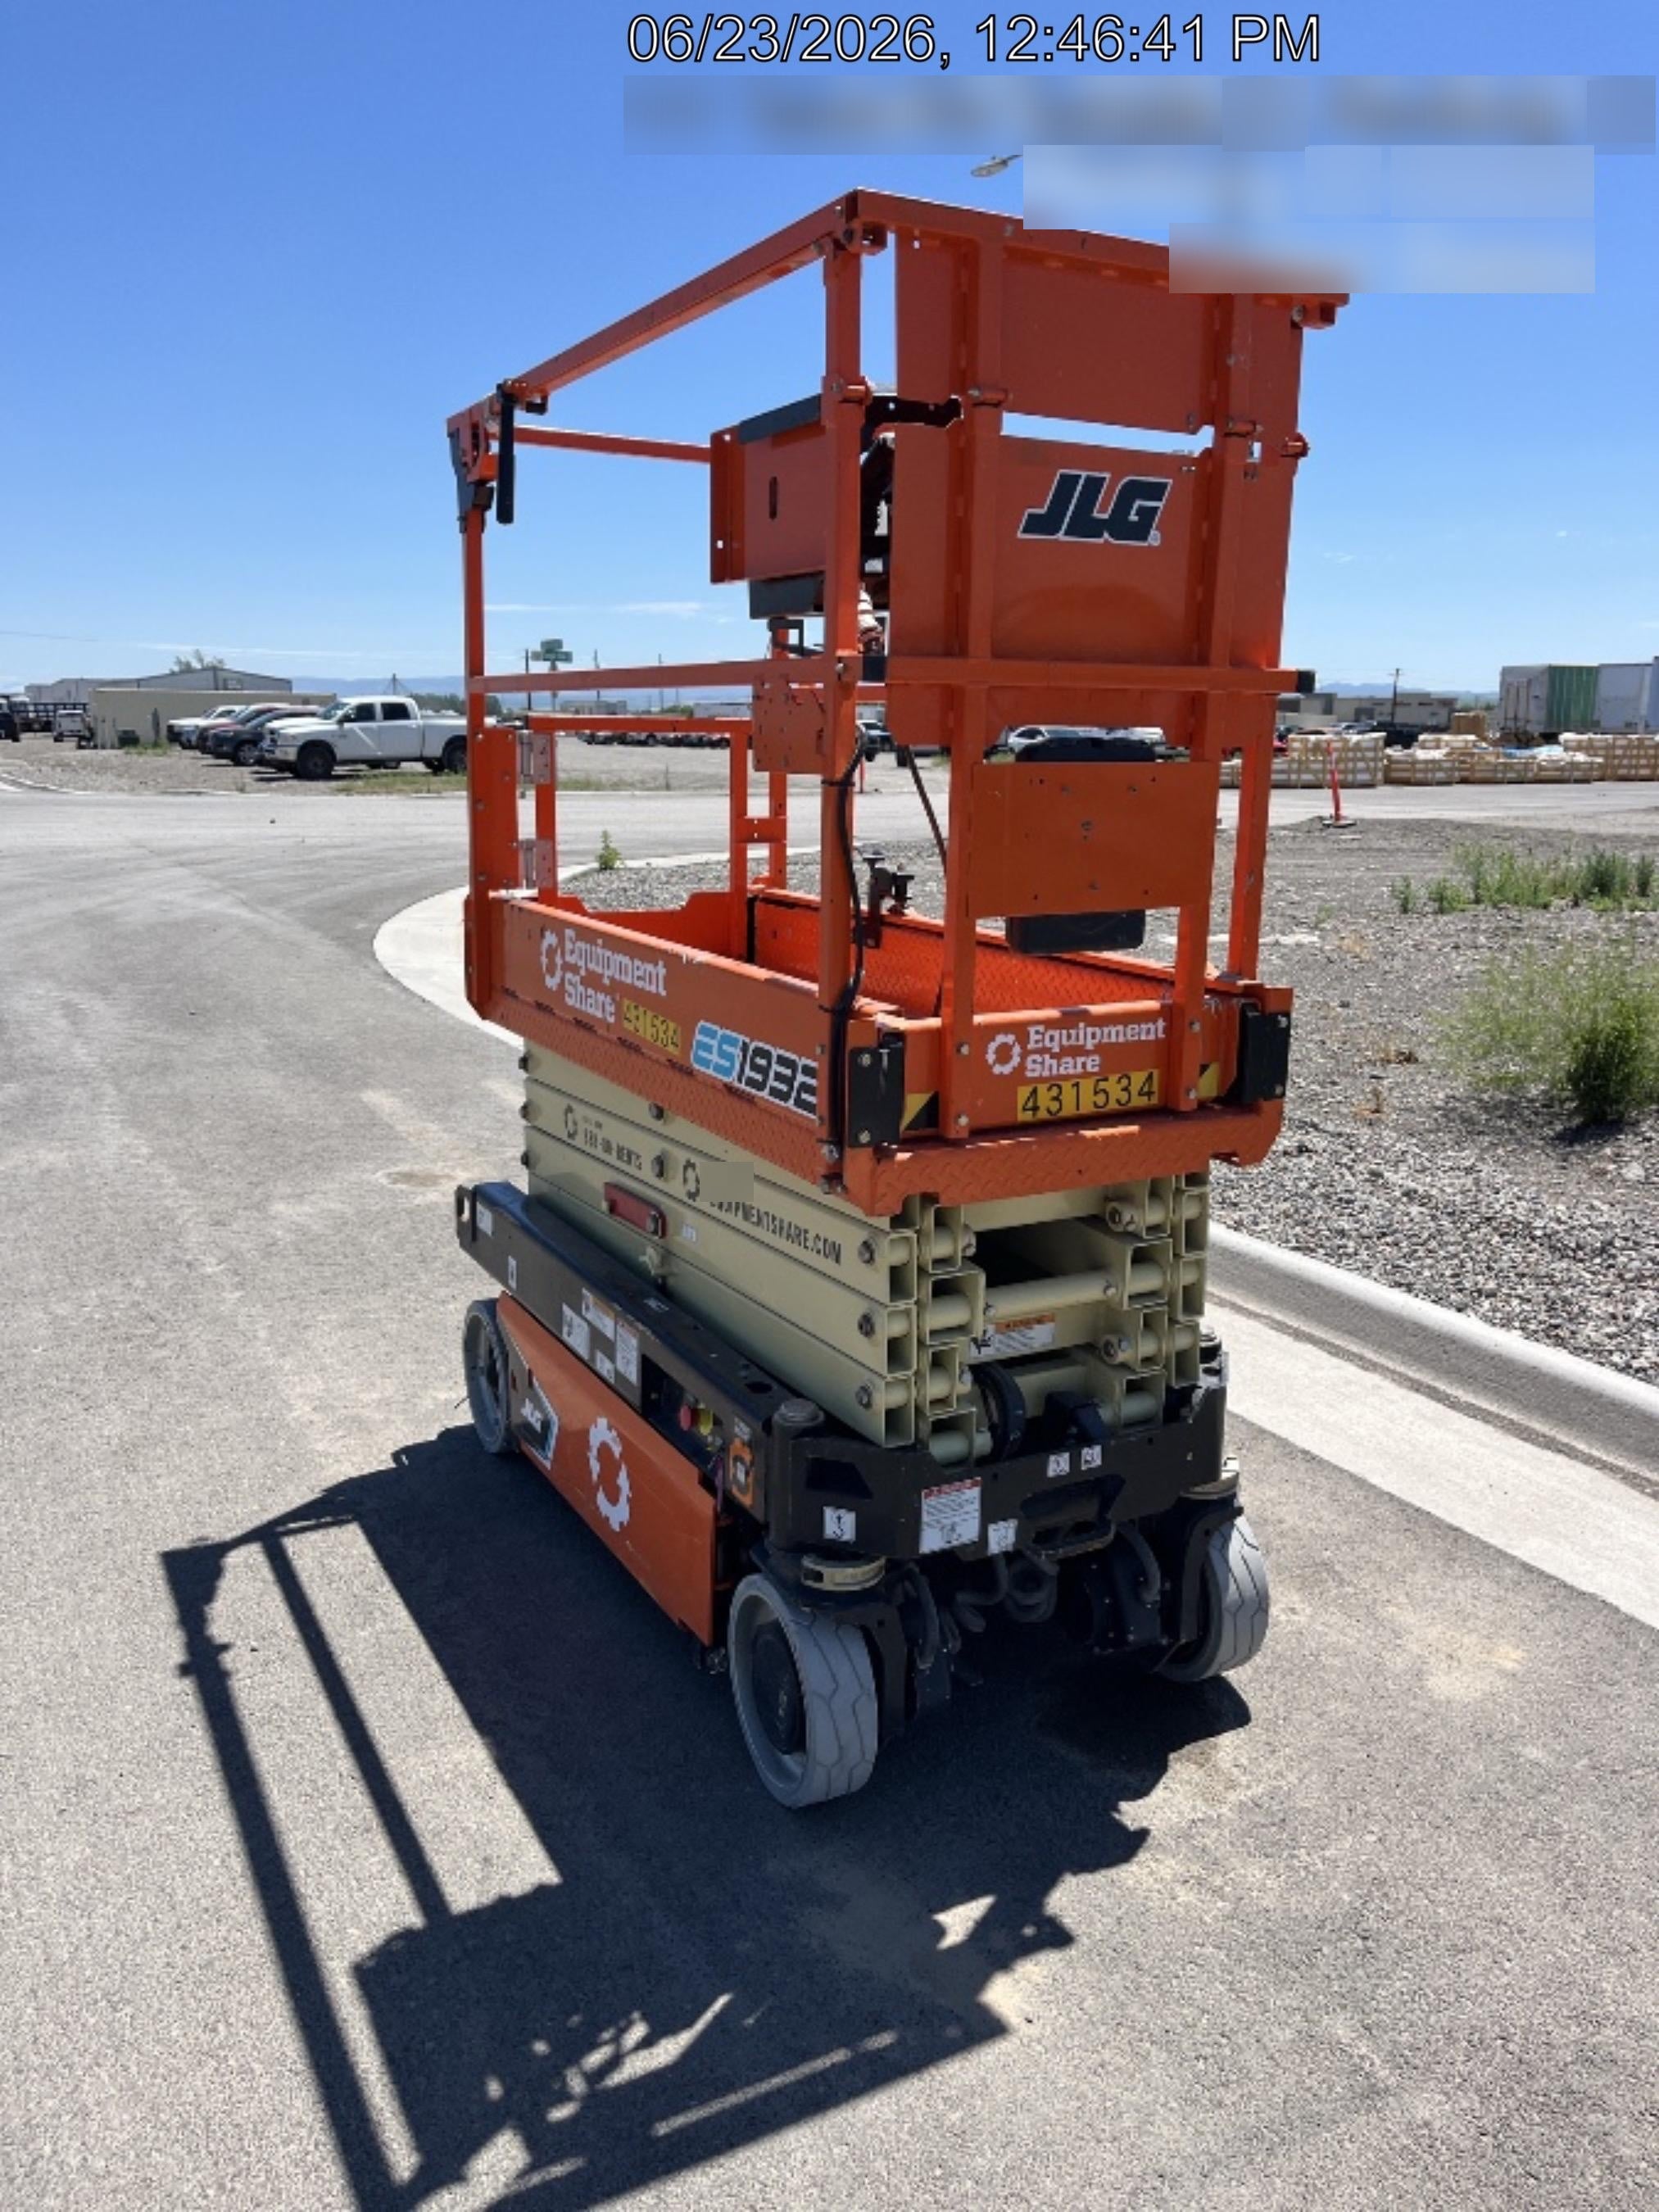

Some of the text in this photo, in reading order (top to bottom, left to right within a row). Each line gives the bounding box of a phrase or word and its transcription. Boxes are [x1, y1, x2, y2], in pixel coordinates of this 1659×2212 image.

[1018, 469, 1173, 546] JLG
[564, 928, 667, 996] Equipment
[564, 972, 615, 1023] Share
[1027, 1018, 1167, 1052] Equipment
[1025, 1054, 1100, 1077] Share
[1022, 1071, 1156, 1119] 431534
